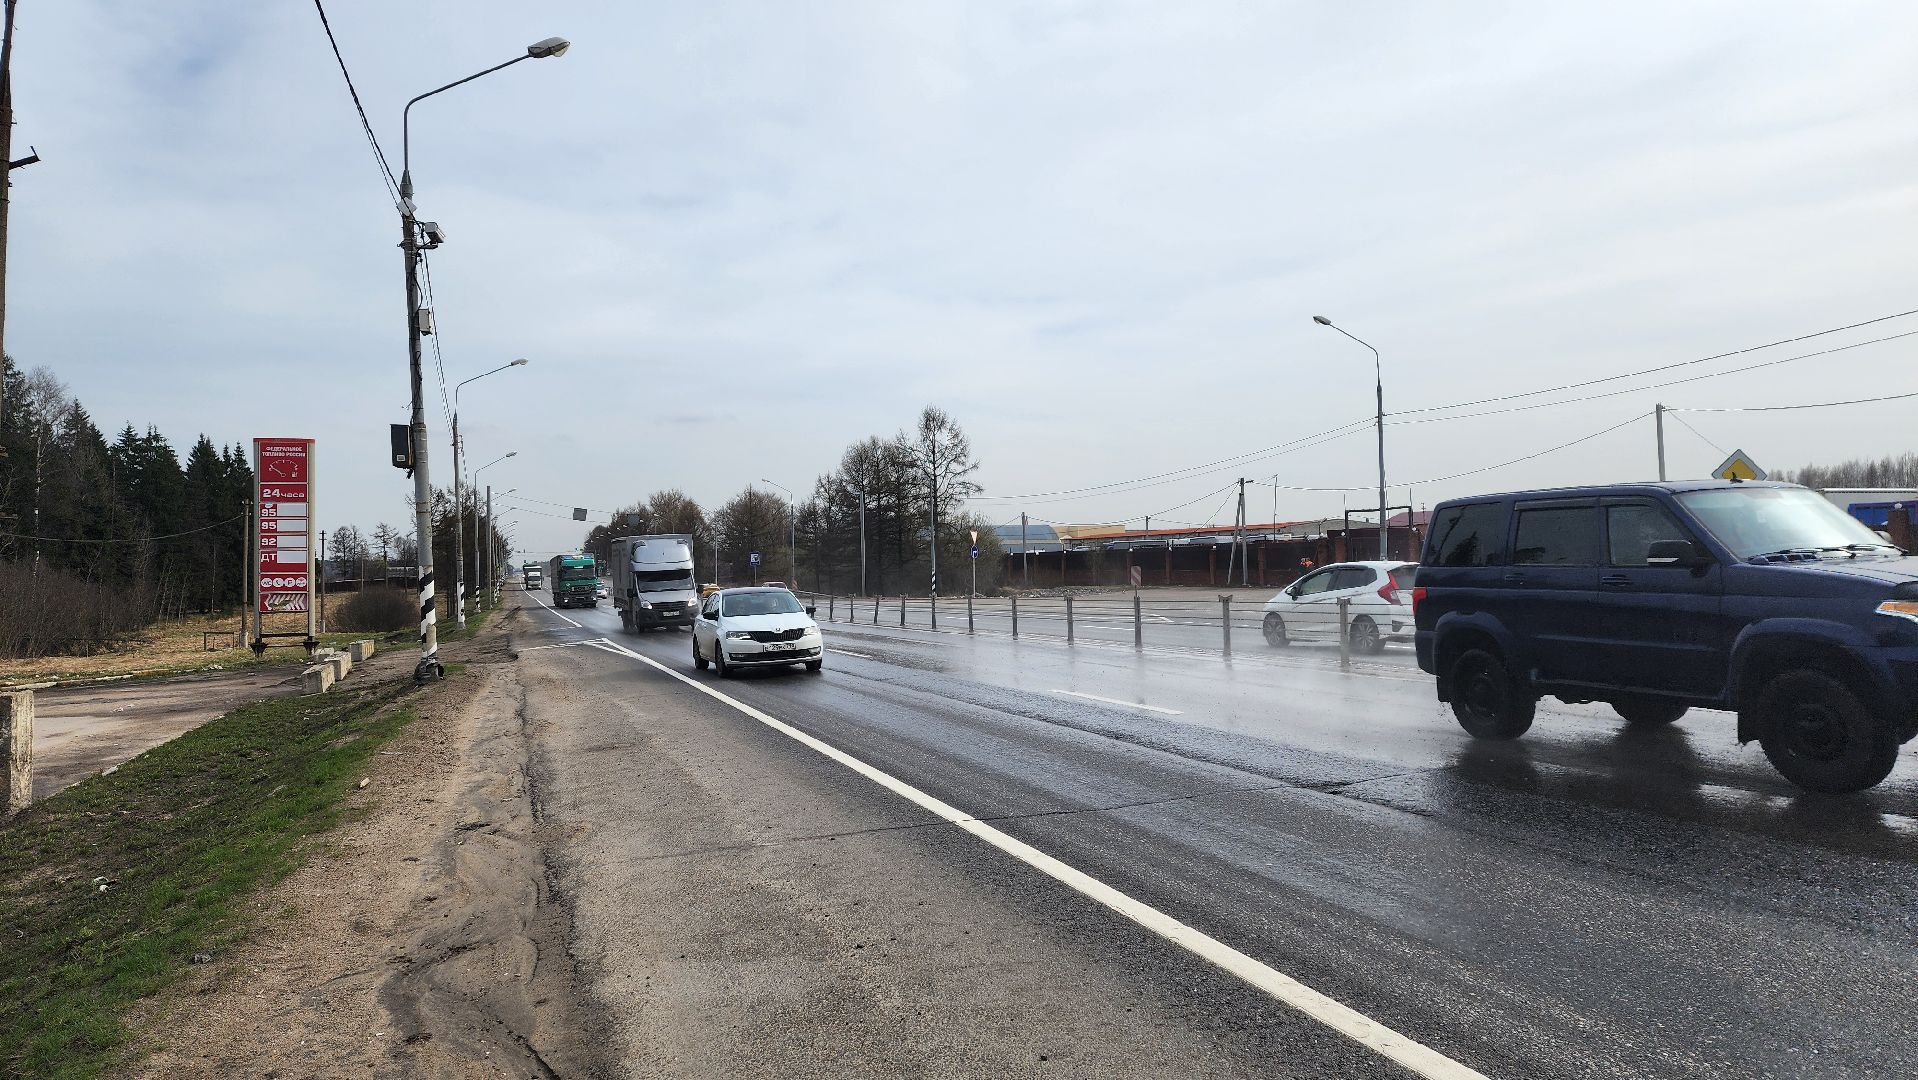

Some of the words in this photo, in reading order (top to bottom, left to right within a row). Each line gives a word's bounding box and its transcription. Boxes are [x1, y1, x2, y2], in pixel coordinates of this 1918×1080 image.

[262, 488, 280, 498] 24
[261, 508, 276, 516] 95
[261, 521, 276, 529] 95
[261, 538, 276, 546] 92
[260, 553, 277, 563] ДТ
